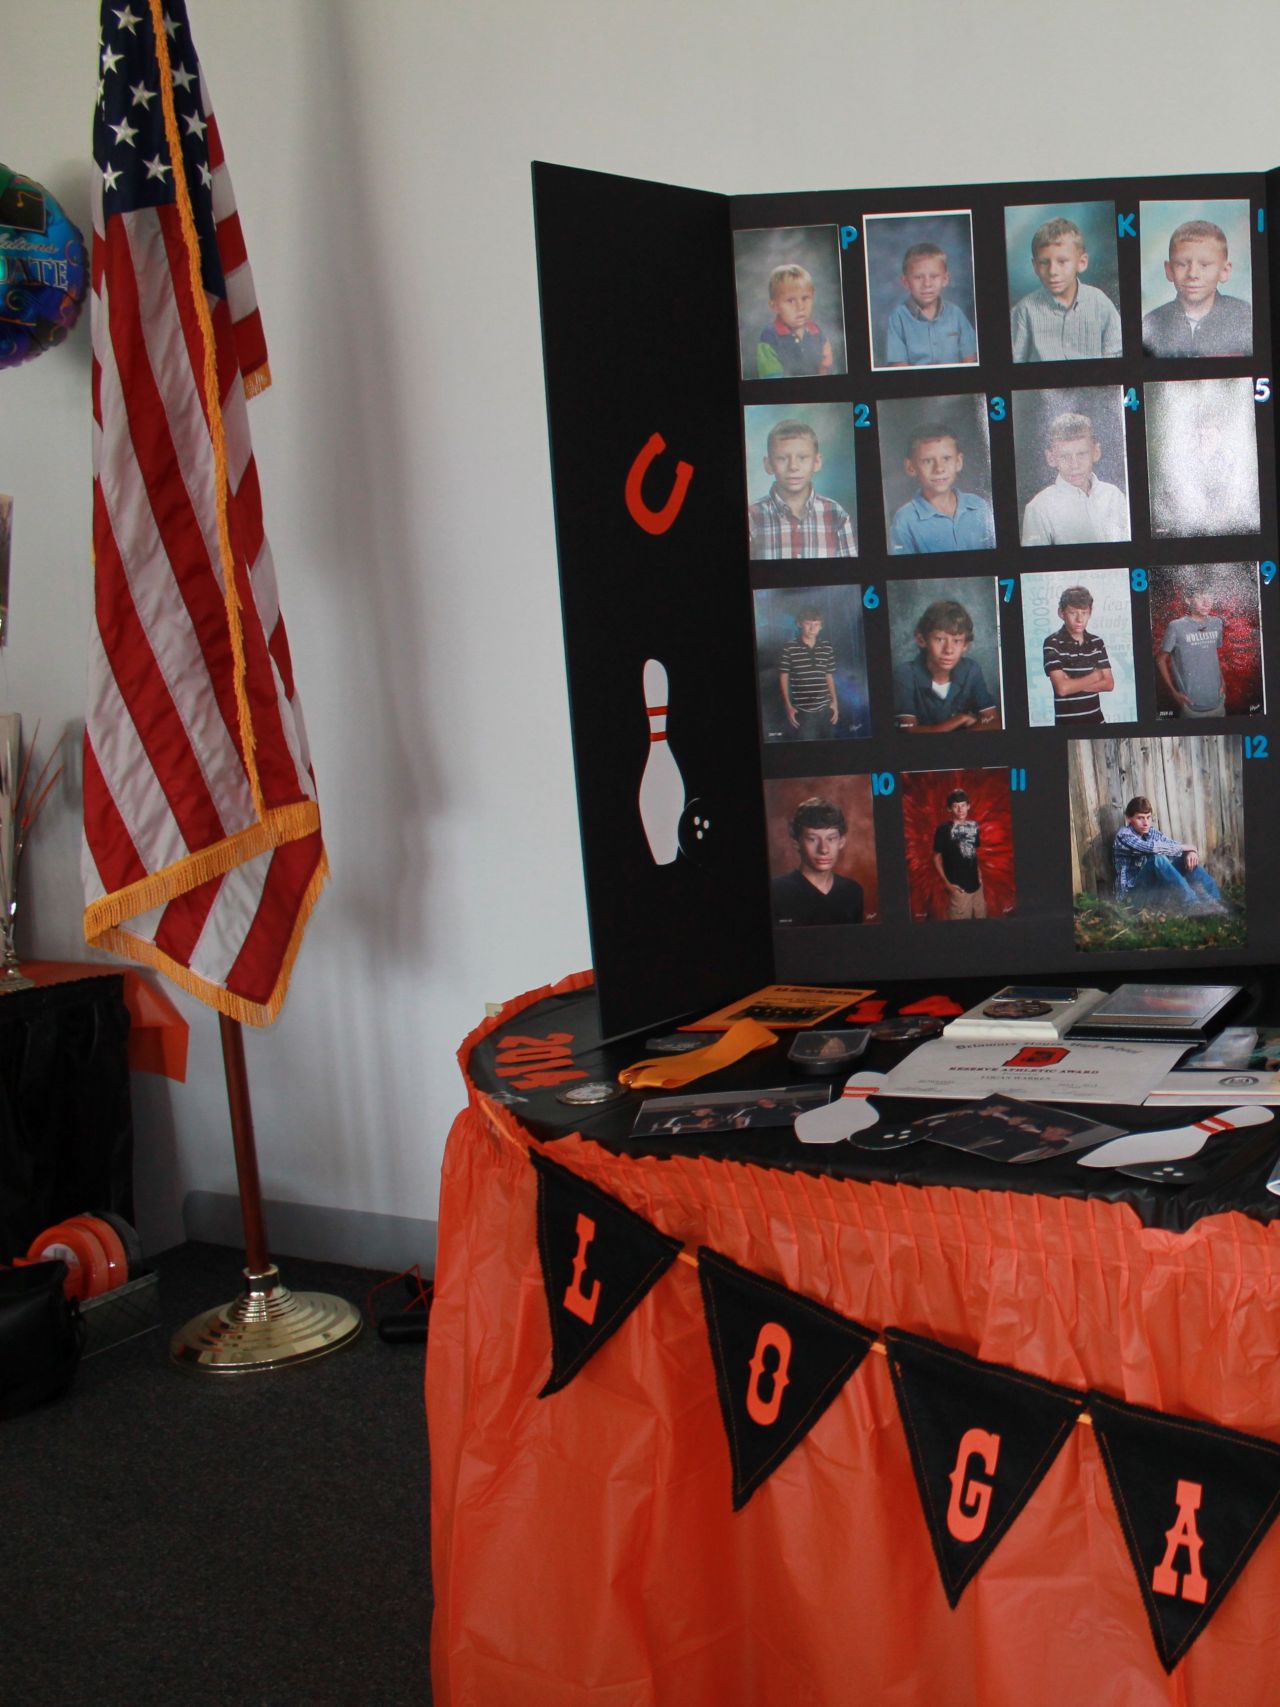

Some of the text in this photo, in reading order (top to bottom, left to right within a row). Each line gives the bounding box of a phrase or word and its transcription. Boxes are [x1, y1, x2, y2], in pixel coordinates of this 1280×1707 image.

[840, 225, 858, 251] P
[1117, 213, 1138, 238] K
[1122, 387, 1140, 412] 4
[1254, 378, 1271, 404] 5
[853, 403, 872, 429] 2
[989, 396, 1007, 422] 3
[1130, 566, 1149, 593] 8
[1259, 559, 1278, 586] 9
[862, 584, 881, 611] 6
[998, 577, 1016, 604] 7
[1243, 734, 1270, 760] 12
[870, 771, 896, 797] 10
